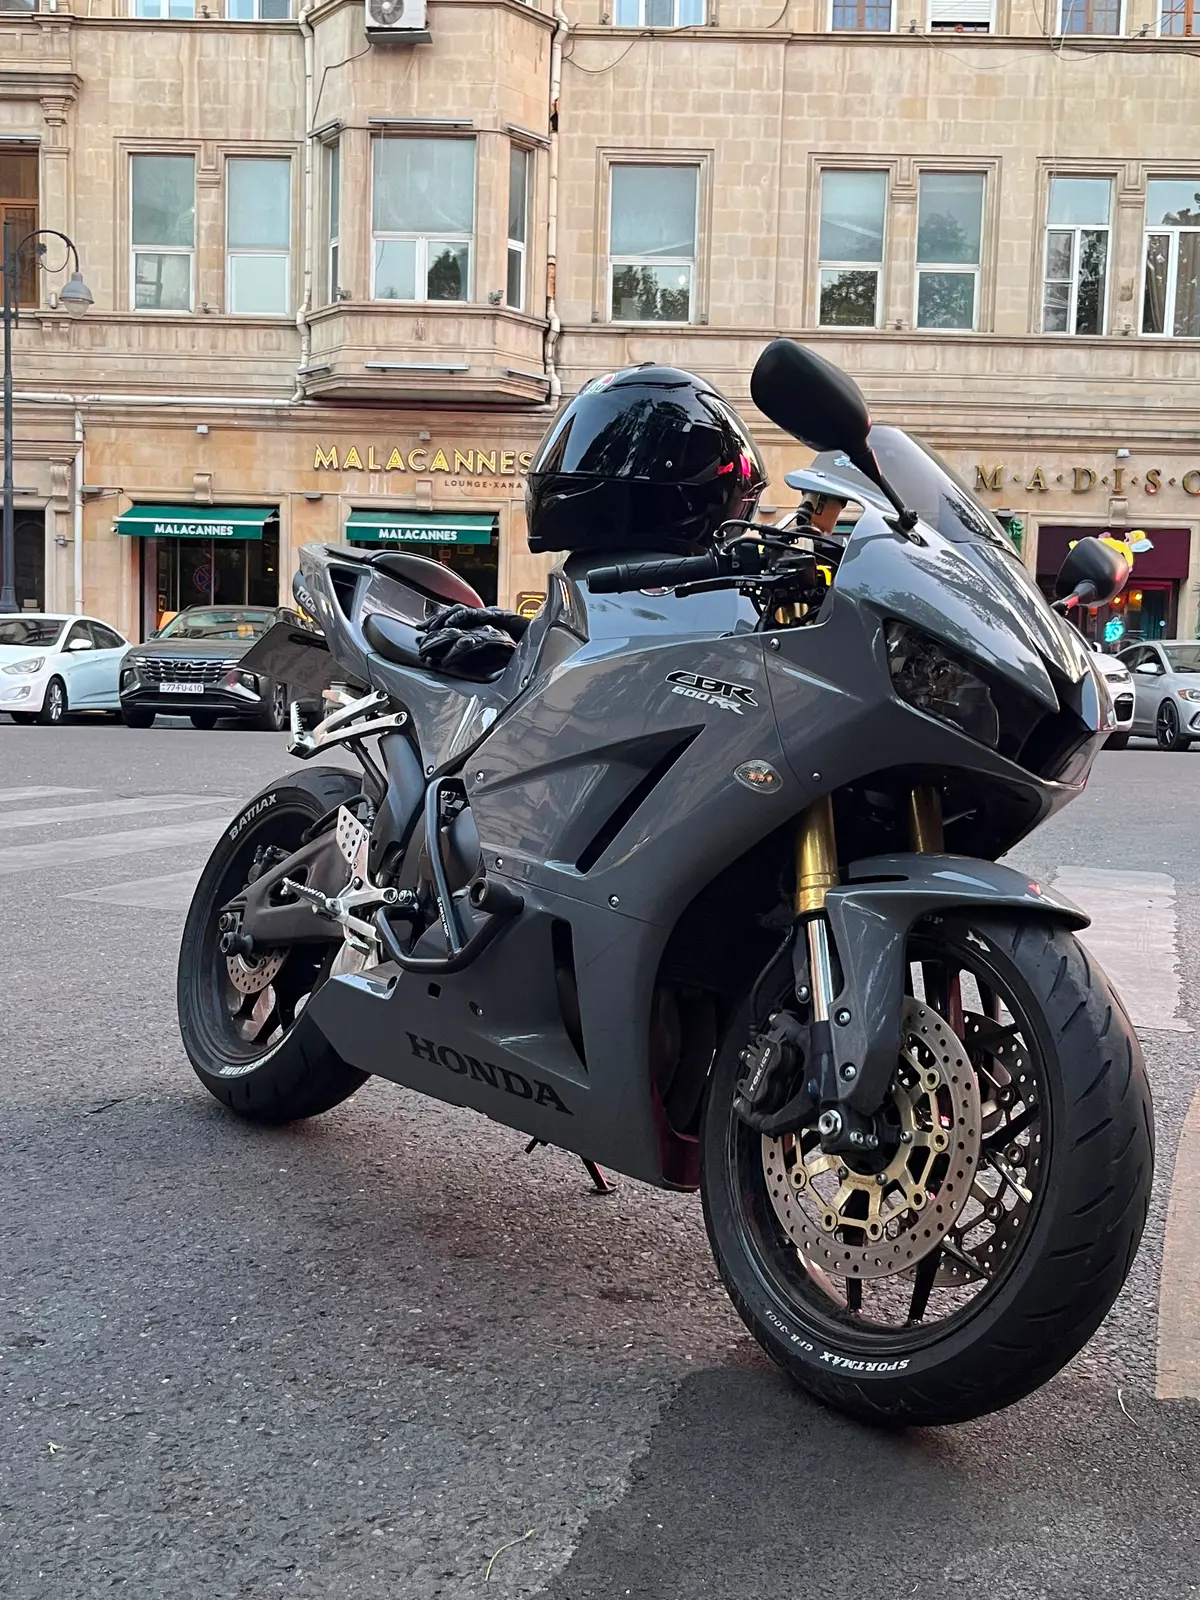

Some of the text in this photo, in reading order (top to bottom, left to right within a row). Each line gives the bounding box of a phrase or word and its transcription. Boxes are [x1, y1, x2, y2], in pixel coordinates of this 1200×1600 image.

[313, 444, 534, 476] MALACANNES
[154, 523, 234, 536] MALACANNES
[378, 528, 458, 541] MALACANNES
[664, 669, 759, 707] CBR
[671, 685, 744, 715] 600RR
[228, 793, 277, 841] BATTLAX
[404, 1030, 575, 1117] HONDA
[748, 1047, 771, 1092] TOKICO
[819, 1351, 911, 1372] SPORTMAX
